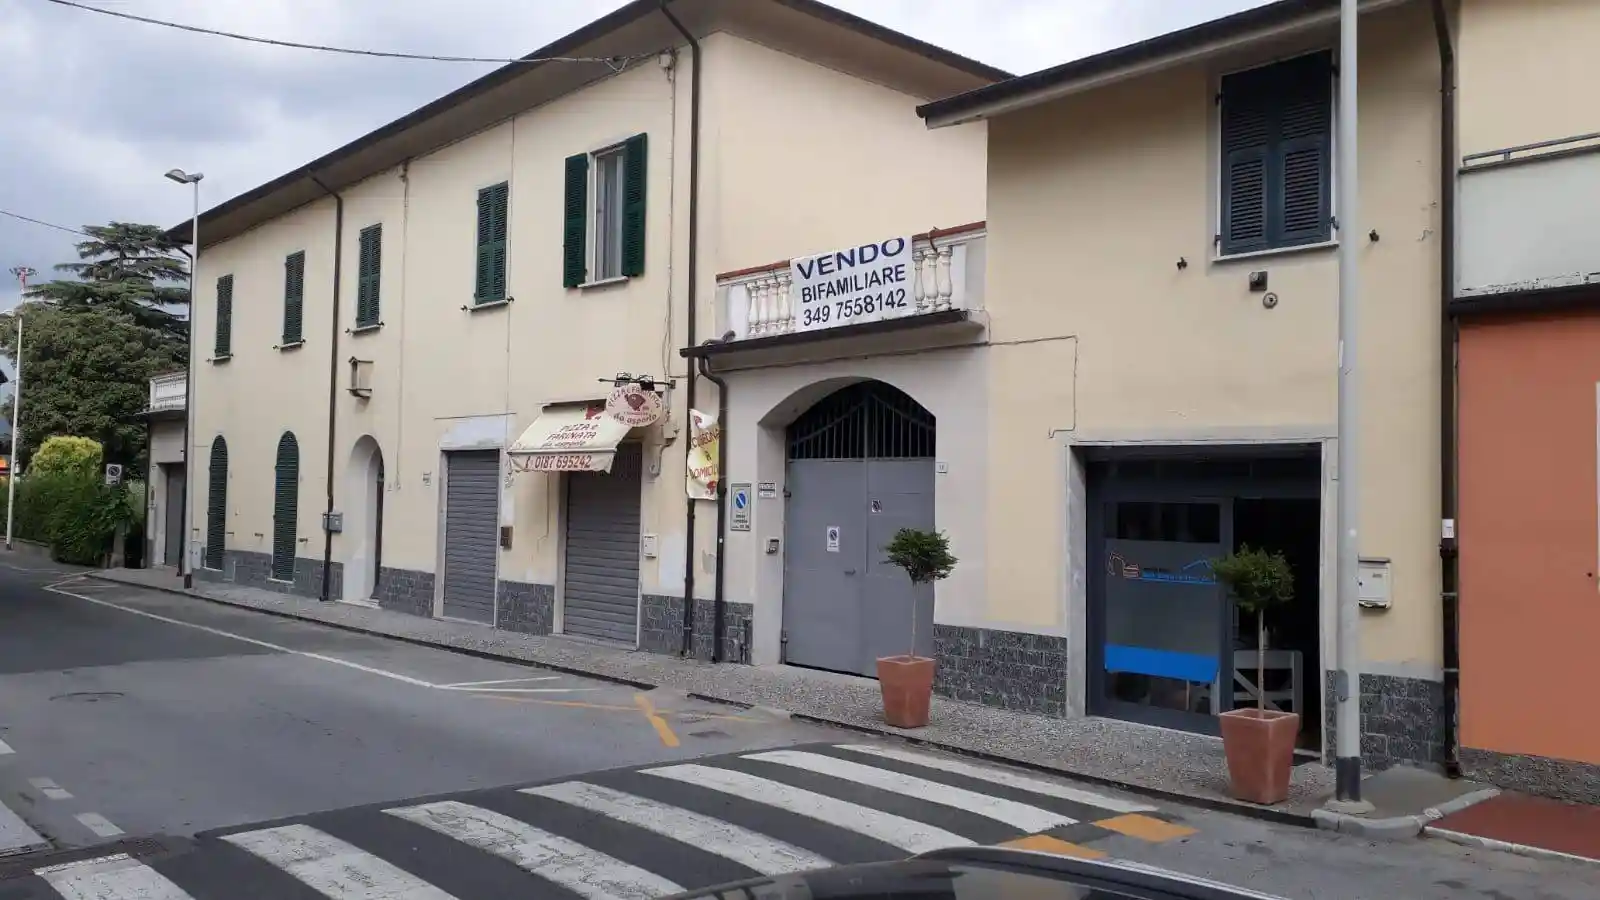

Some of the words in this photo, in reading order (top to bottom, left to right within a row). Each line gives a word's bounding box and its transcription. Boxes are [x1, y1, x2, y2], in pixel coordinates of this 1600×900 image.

[796, 237, 905, 280] VENDO
[801, 263, 906, 304] BIFAMILIARE
[803, 304, 831, 327] 349
[835, 288, 908, 320] 7558142
[546, 431, 598, 442] FARINATA
[559, 423, 591, 433] PIZZA
[534, 455, 555, 469] 0187
[556, 454, 593, 469] 695242
